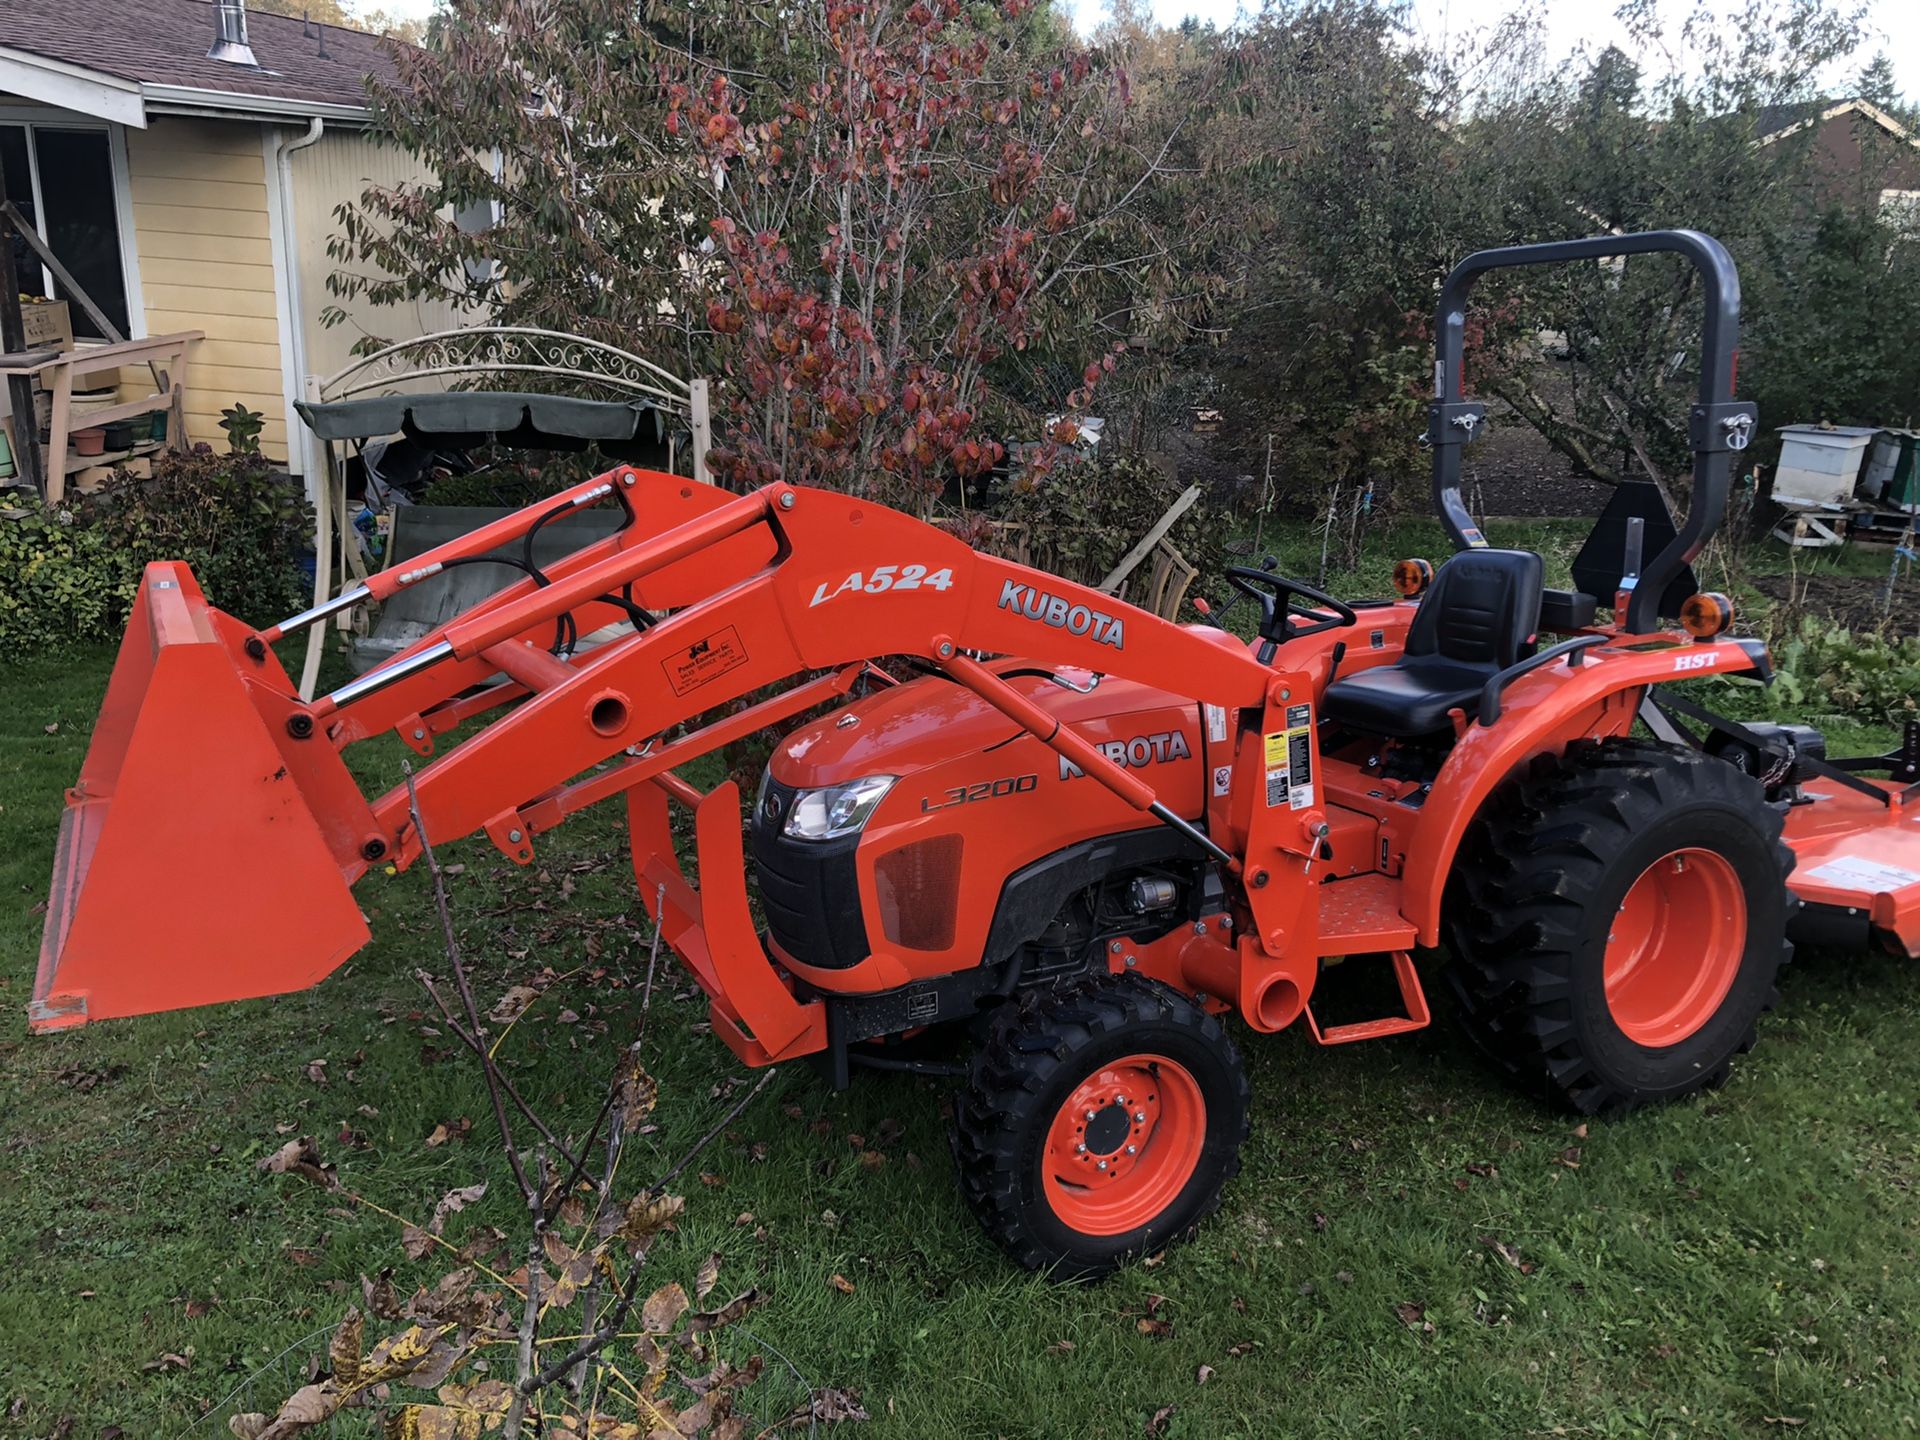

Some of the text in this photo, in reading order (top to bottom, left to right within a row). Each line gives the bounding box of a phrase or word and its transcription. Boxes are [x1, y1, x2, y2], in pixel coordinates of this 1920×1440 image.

[808, 564, 953, 609] LA524
[998, 578, 1125, 650] KUBOTA
[1673, 652, 1719, 671] HST
[1059, 730, 1191, 780] KBOTA
[921, 773, 1038, 813] L3200
